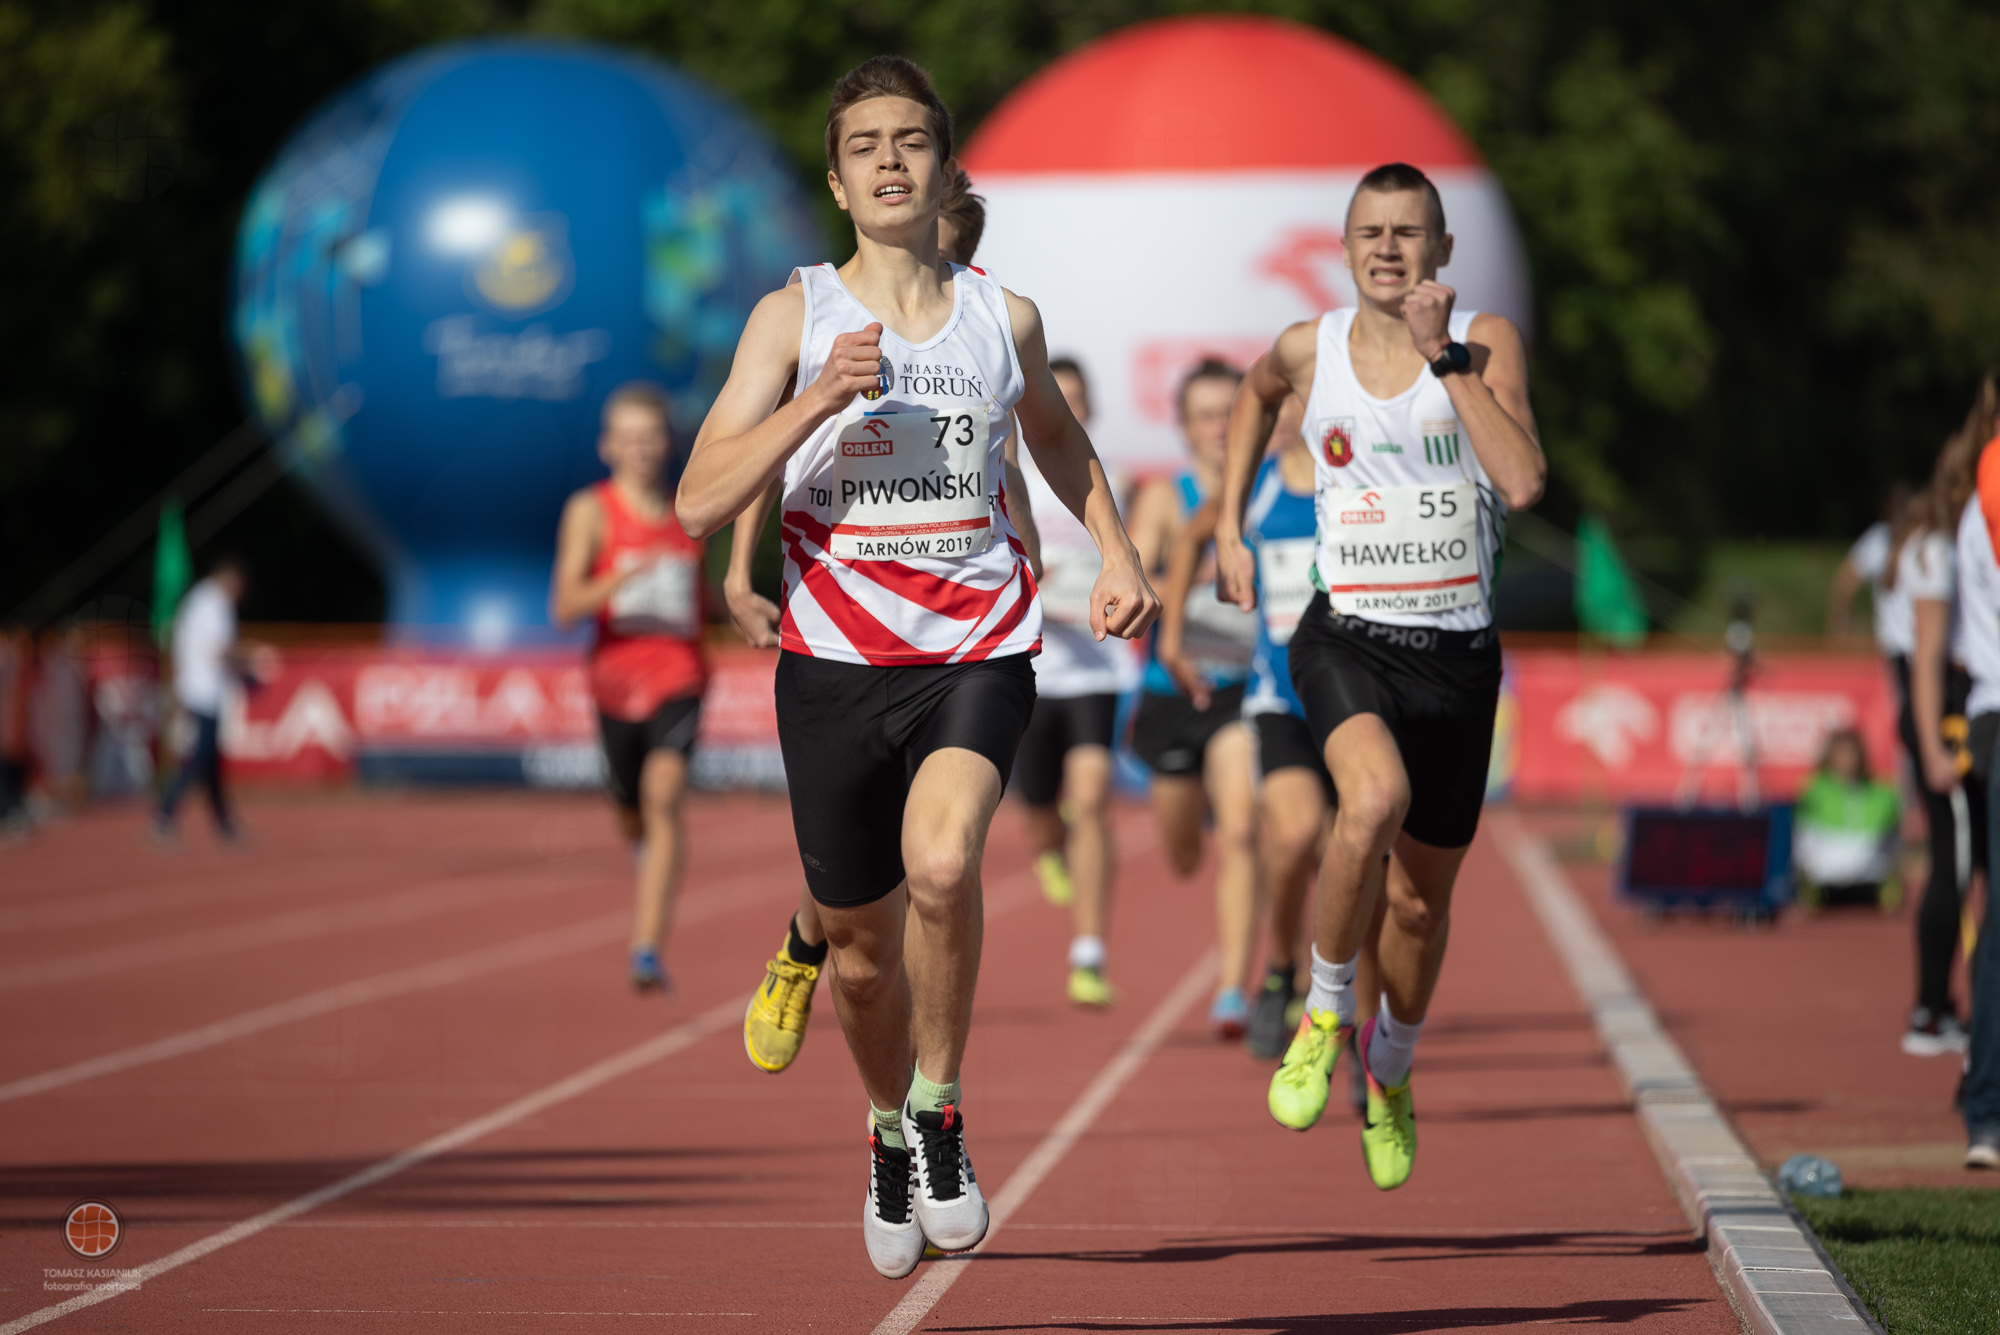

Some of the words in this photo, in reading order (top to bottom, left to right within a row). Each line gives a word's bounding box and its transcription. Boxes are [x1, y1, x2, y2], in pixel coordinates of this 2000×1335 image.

[903, 363, 964, 377] MIASTO
[900, 375, 983, 398] TORUŃ
[930, 415, 974, 448] 73
[843, 442, 891, 456] ORLEN
[841, 470, 981, 505] PIWOŃSKI
[1419, 491, 1457, 519] 55
[1341, 511, 1385, 524] ORLEN
[856, 537, 930, 556] TARNÓW
[936, 536, 972, 553] 2019
[1340, 539, 1467, 566] HAWEŁKO
[1355, 592, 1419, 609] TARNÓW
[1425, 592, 1457, 607] 2019
